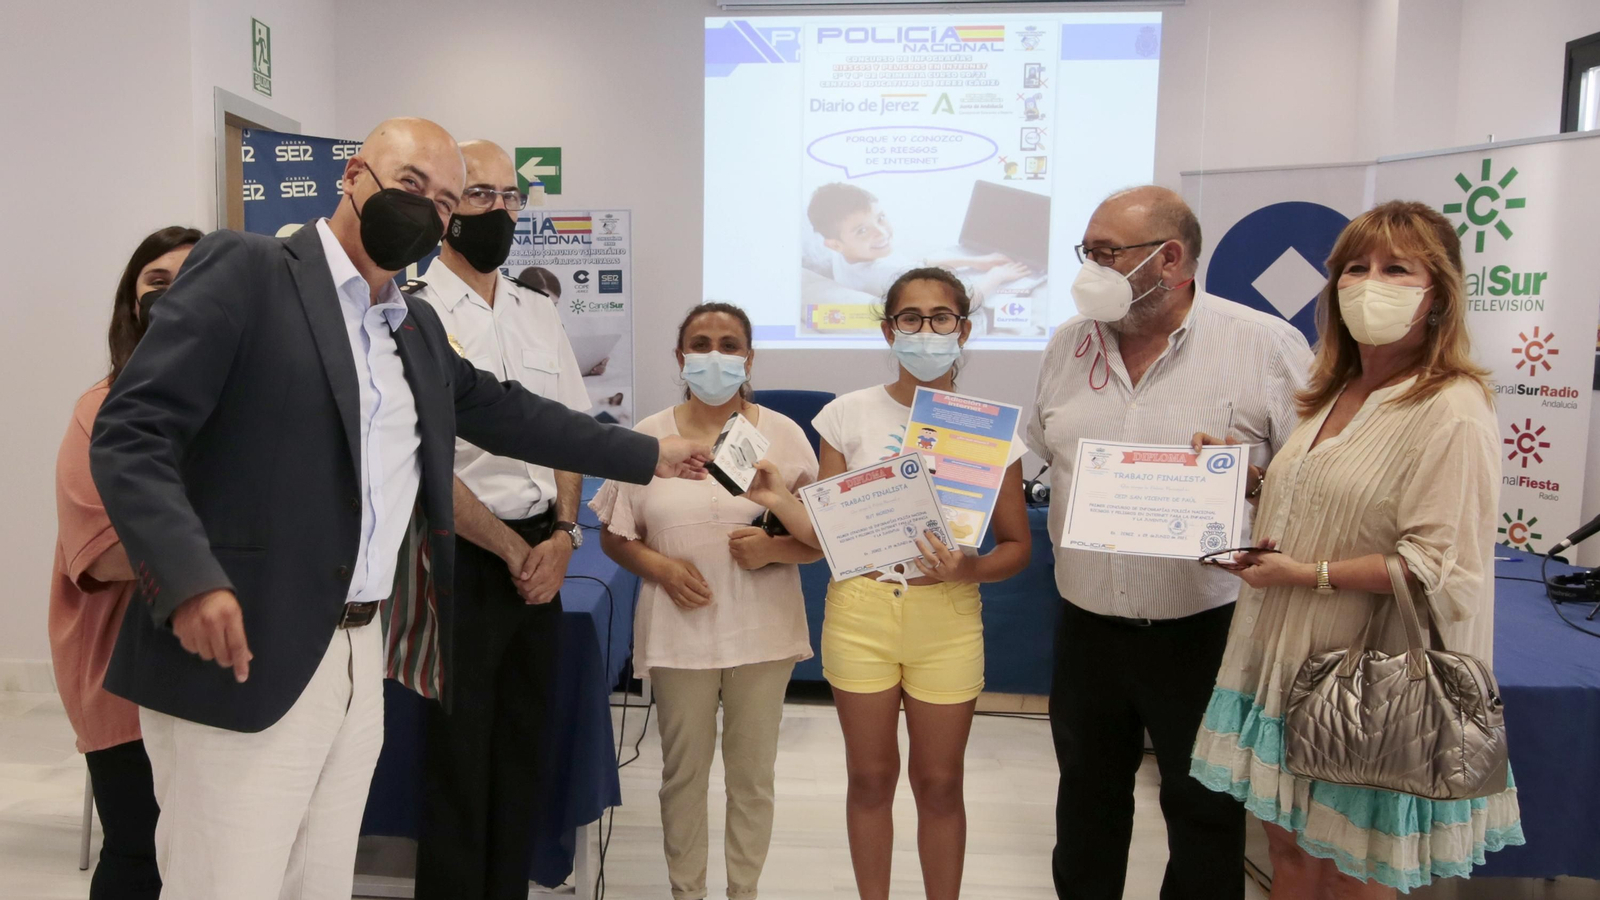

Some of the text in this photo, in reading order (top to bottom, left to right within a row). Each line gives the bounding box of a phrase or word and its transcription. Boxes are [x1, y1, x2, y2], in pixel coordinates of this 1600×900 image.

[903, 43, 1004, 53] NACIONAL
[846, 55, 895, 63] CONCURSO
[911, 54, 973, 62] INFOGRAFÍAS
[881, 63, 926, 71] PELIGROS
[810, 98, 919, 116] Diario de Jerez
[275, 145, 313, 161] SER
[280, 181, 317, 197] SER
[513, 235, 592, 245] NACIONAL
[1468, 297, 1544, 311] TELEVISIÓN
[948, 401, 982, 412] Internet
[1542, 400, 1577, 409] Andalucía
[1133, 452, 1187, 463] DIPLOMA
[846, 468, 887, 488] DIPLOMA
[1113, 472, 1153, 481] TRABAJO
[1157, 474, 1206, 482] FINALISTA
[1502, 475, 1559, 491] nalFiesta
[841, 494, 870, 508] TRABAJO
[872, 484, 908, 499] FINALISTA
[1539, 492, 1558, 501] Radio
